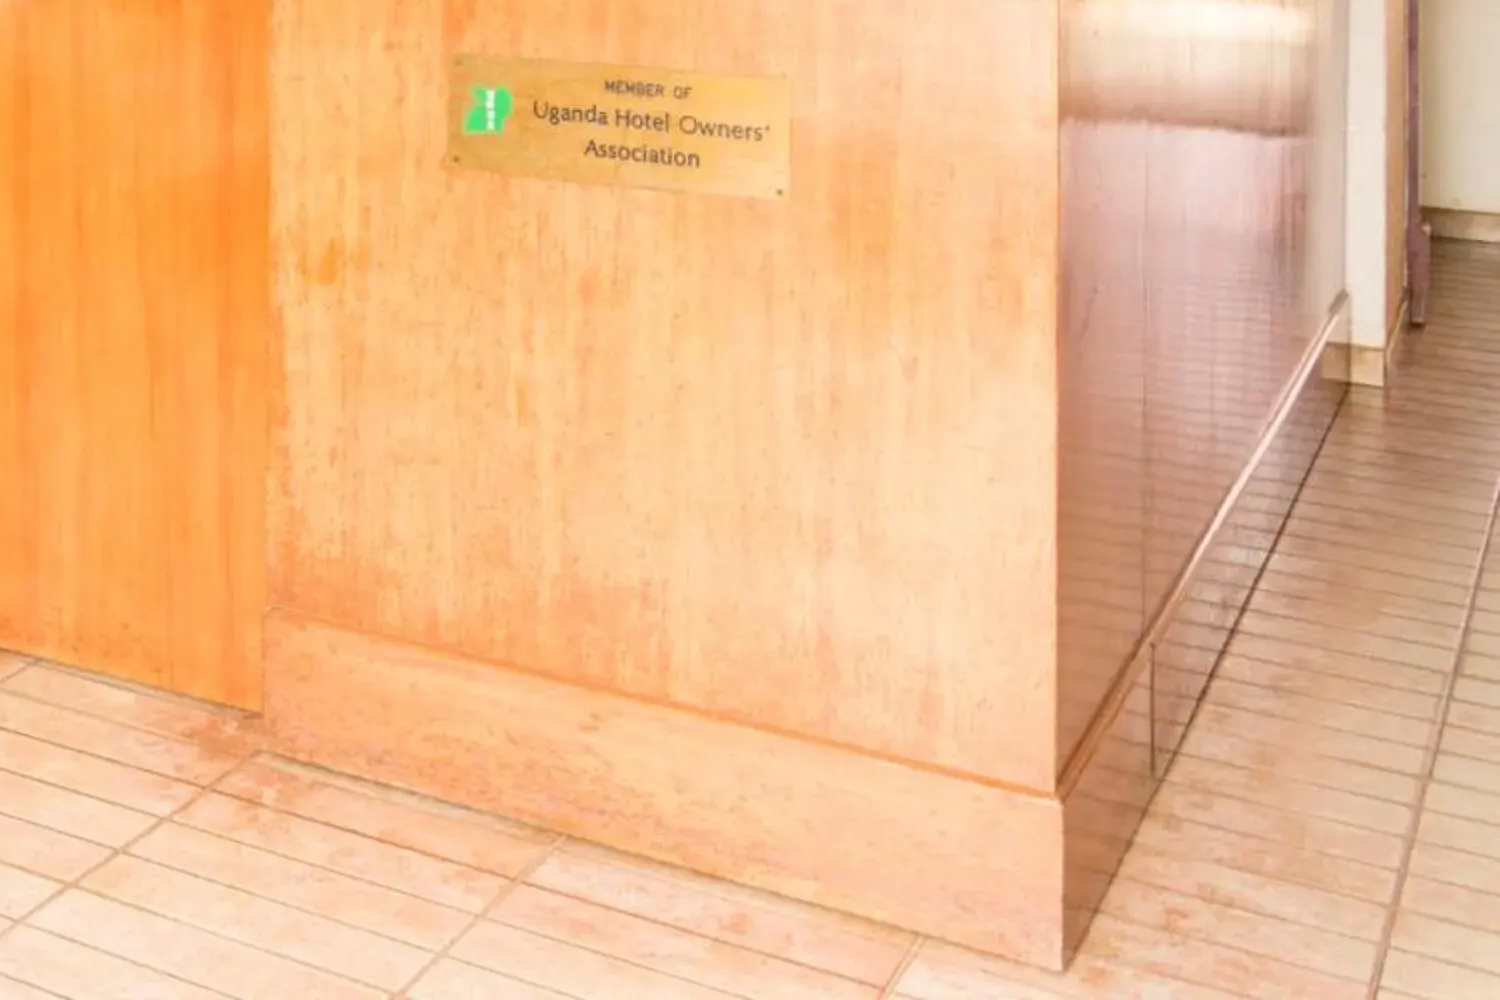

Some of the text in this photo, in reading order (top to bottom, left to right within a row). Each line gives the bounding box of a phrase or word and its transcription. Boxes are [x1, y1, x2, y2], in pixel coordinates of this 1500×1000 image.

[604, 79, 693, 100] MEMBER OF
[532, 99, 771, 142] Uganda Hotel Owners'
[583, 138, 701, 169] Association
